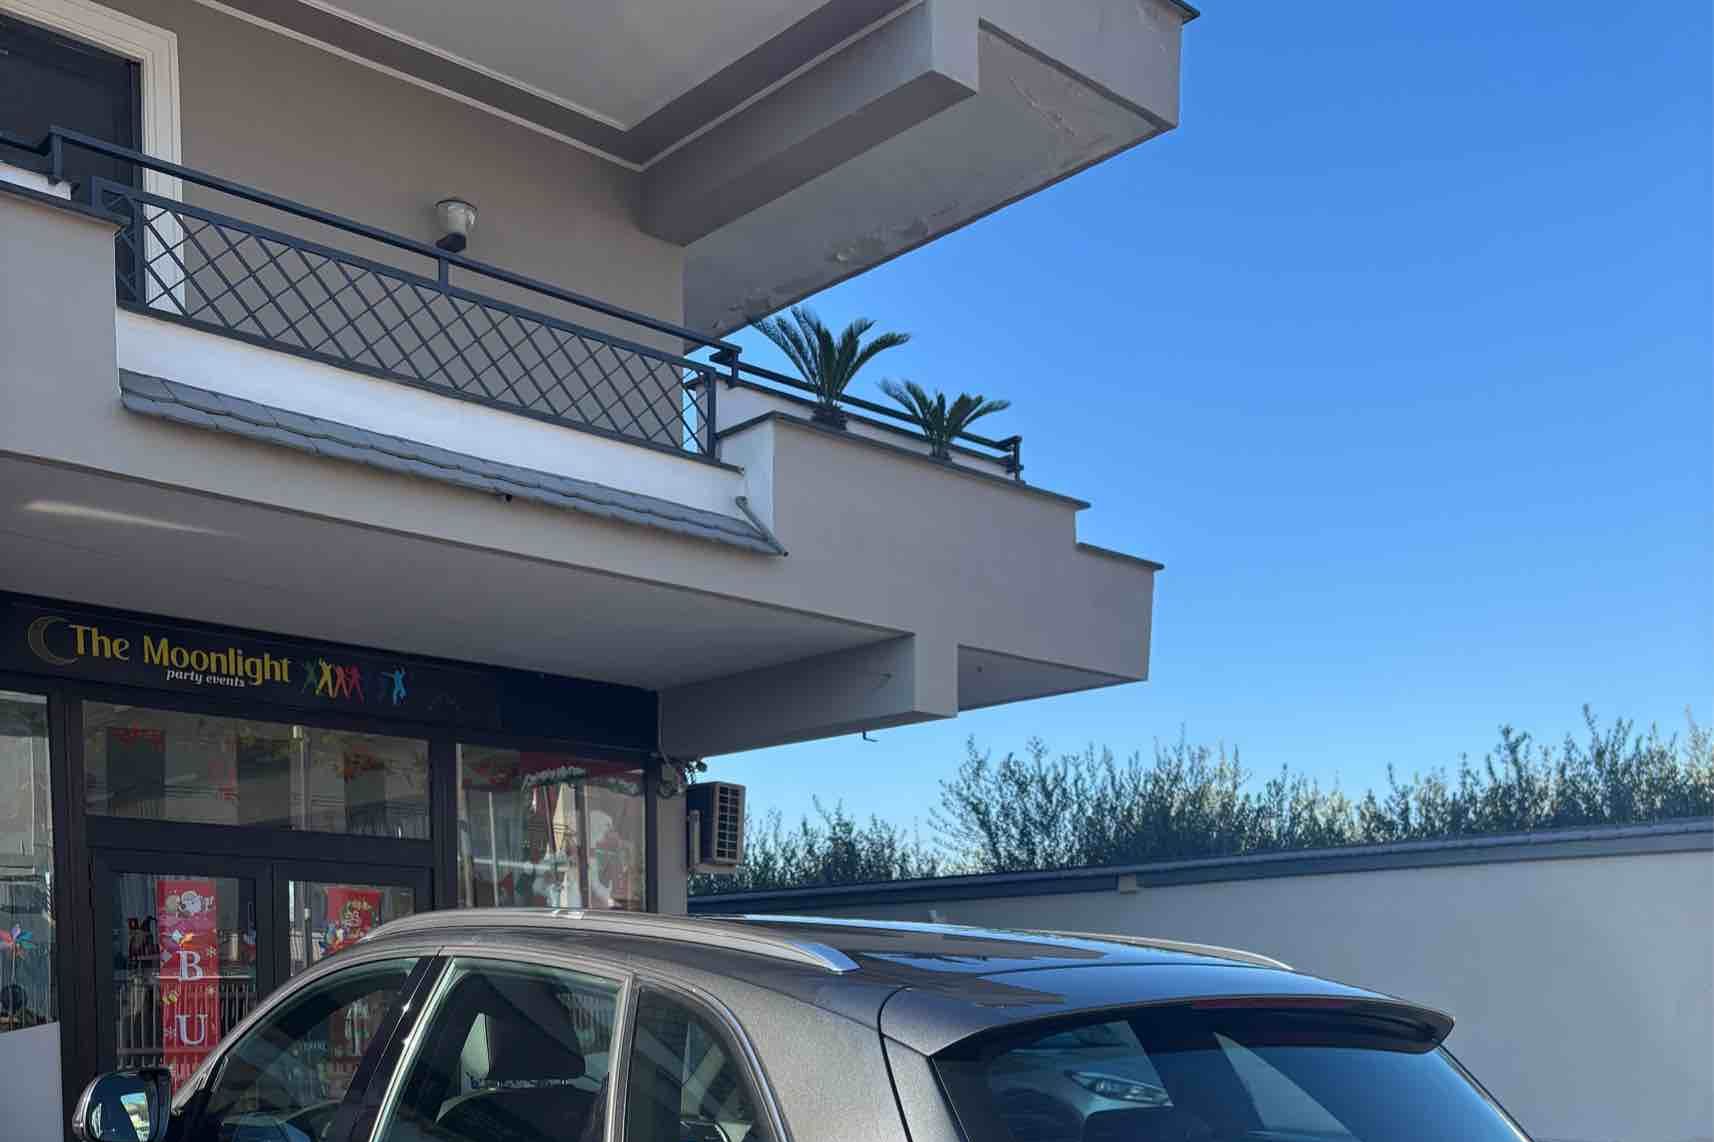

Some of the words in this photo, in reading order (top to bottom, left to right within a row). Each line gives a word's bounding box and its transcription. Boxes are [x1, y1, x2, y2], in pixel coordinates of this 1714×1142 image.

[69, 623, 130, 660] The
[143, 634, 292, 686] Moonlight
[166, 669, 203, 686] party
[206, 674, 246, 688] events
